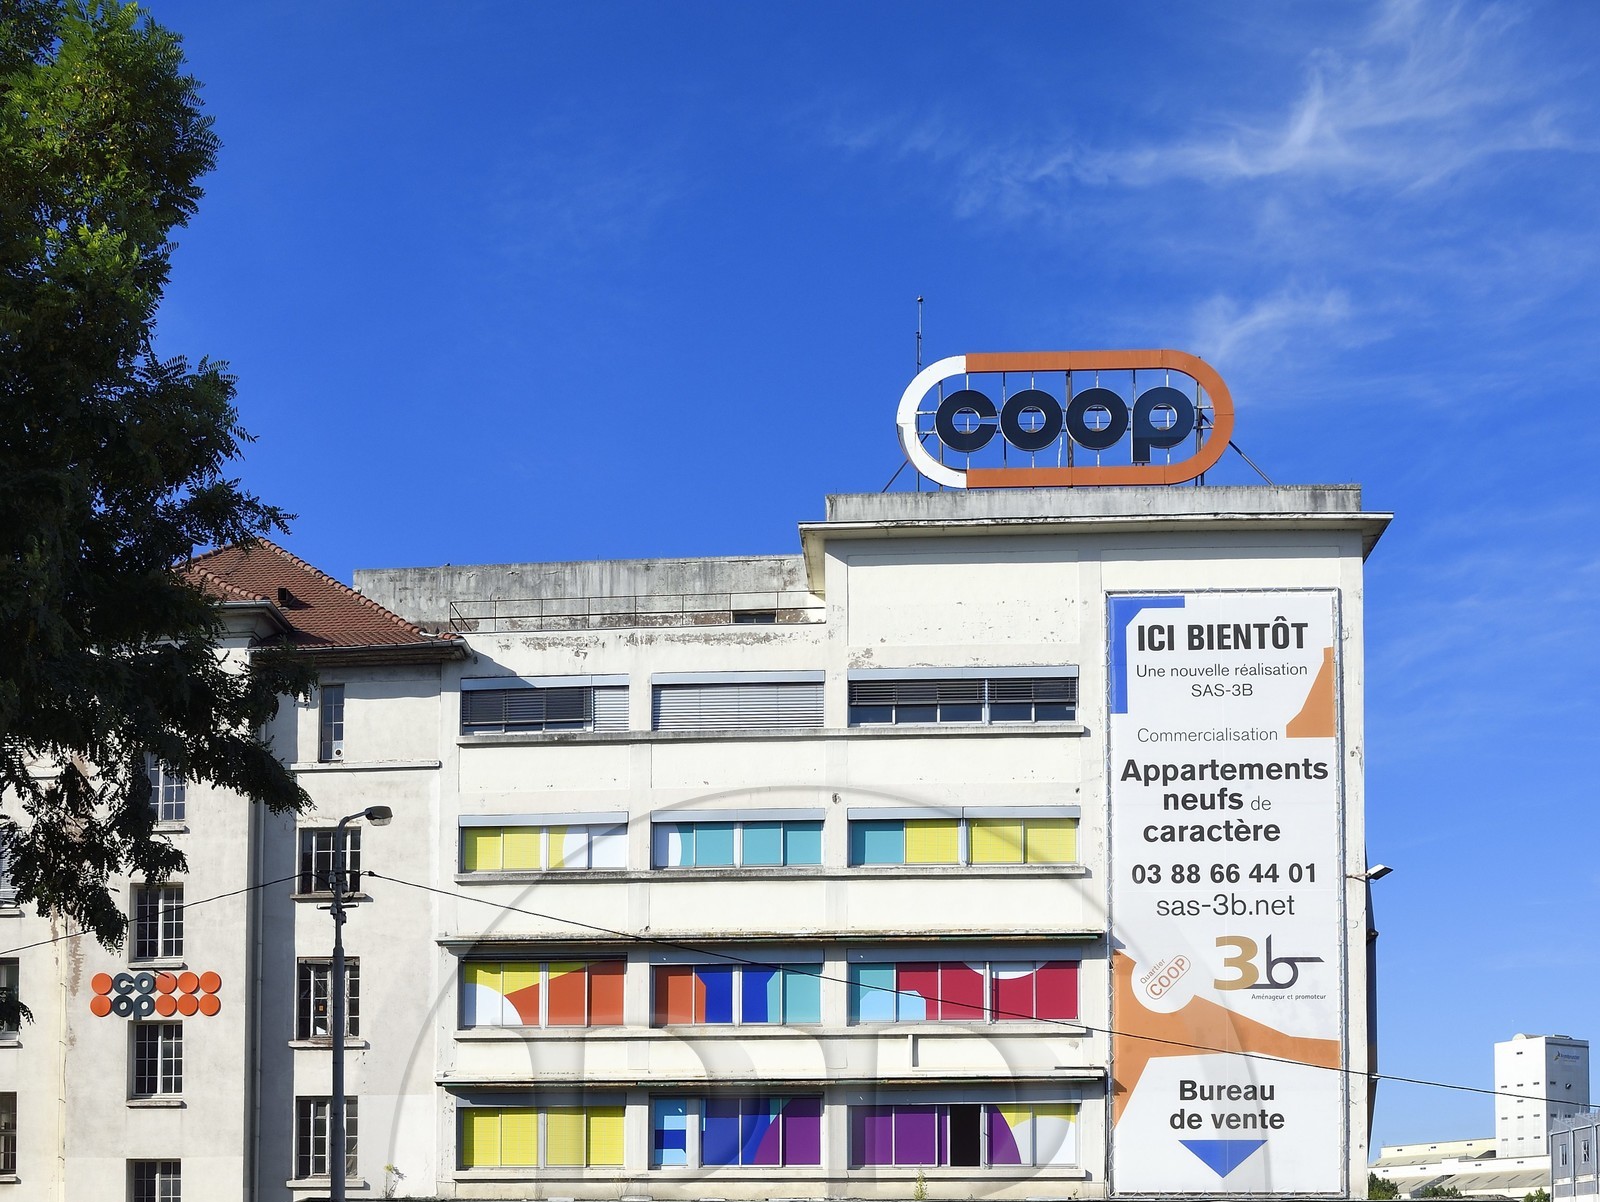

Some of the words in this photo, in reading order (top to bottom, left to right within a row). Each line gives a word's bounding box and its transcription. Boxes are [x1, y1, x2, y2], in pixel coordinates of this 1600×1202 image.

[935, 386, 1195, 463] coop
[1137, 624, 1175, 652] ICI
[1188, 616, 1308, 650] BIENTÔT
[1137, 665, 1165, 677] Une
[1171, 664, 1229, 677] nouvelle
[1235, 663, 1307, 676] réalisation
[1192, 684, 1253, 697] SAS-3B
[1138, 728, 1277, 742] Commercialisation
[1121, 758, 1328, 786] Appartements
[1164, 788, 1243, 810] neufs
[1251, 796, 1271, 810] de
[1144, 819, 1280, 842] caractère
[1132, 864, 1161, 884] 03
[1171, 864, 1200, 884] 88
[1210, 864, 1240, 883] 66
[1249, 864, 1279, 882] 44
[1289, 863, 1315, 883] 01
[1157, 893, 1295, 916] sas-3b.net
[1140, 958, 1166, 984] Quartier
[1213, 934, 1325, 991] 3b
[1150, 958, 1184, 996] COOP
[1251, 993, 1285, 1002] Aménageur
[1294, 993, 1327, 1001] promoteur
[1180, 1080, 1274, 1101] Bureau
[1170, 1109, 1202, 1129] de
[1211, 1109, 1284, 1129] vente
